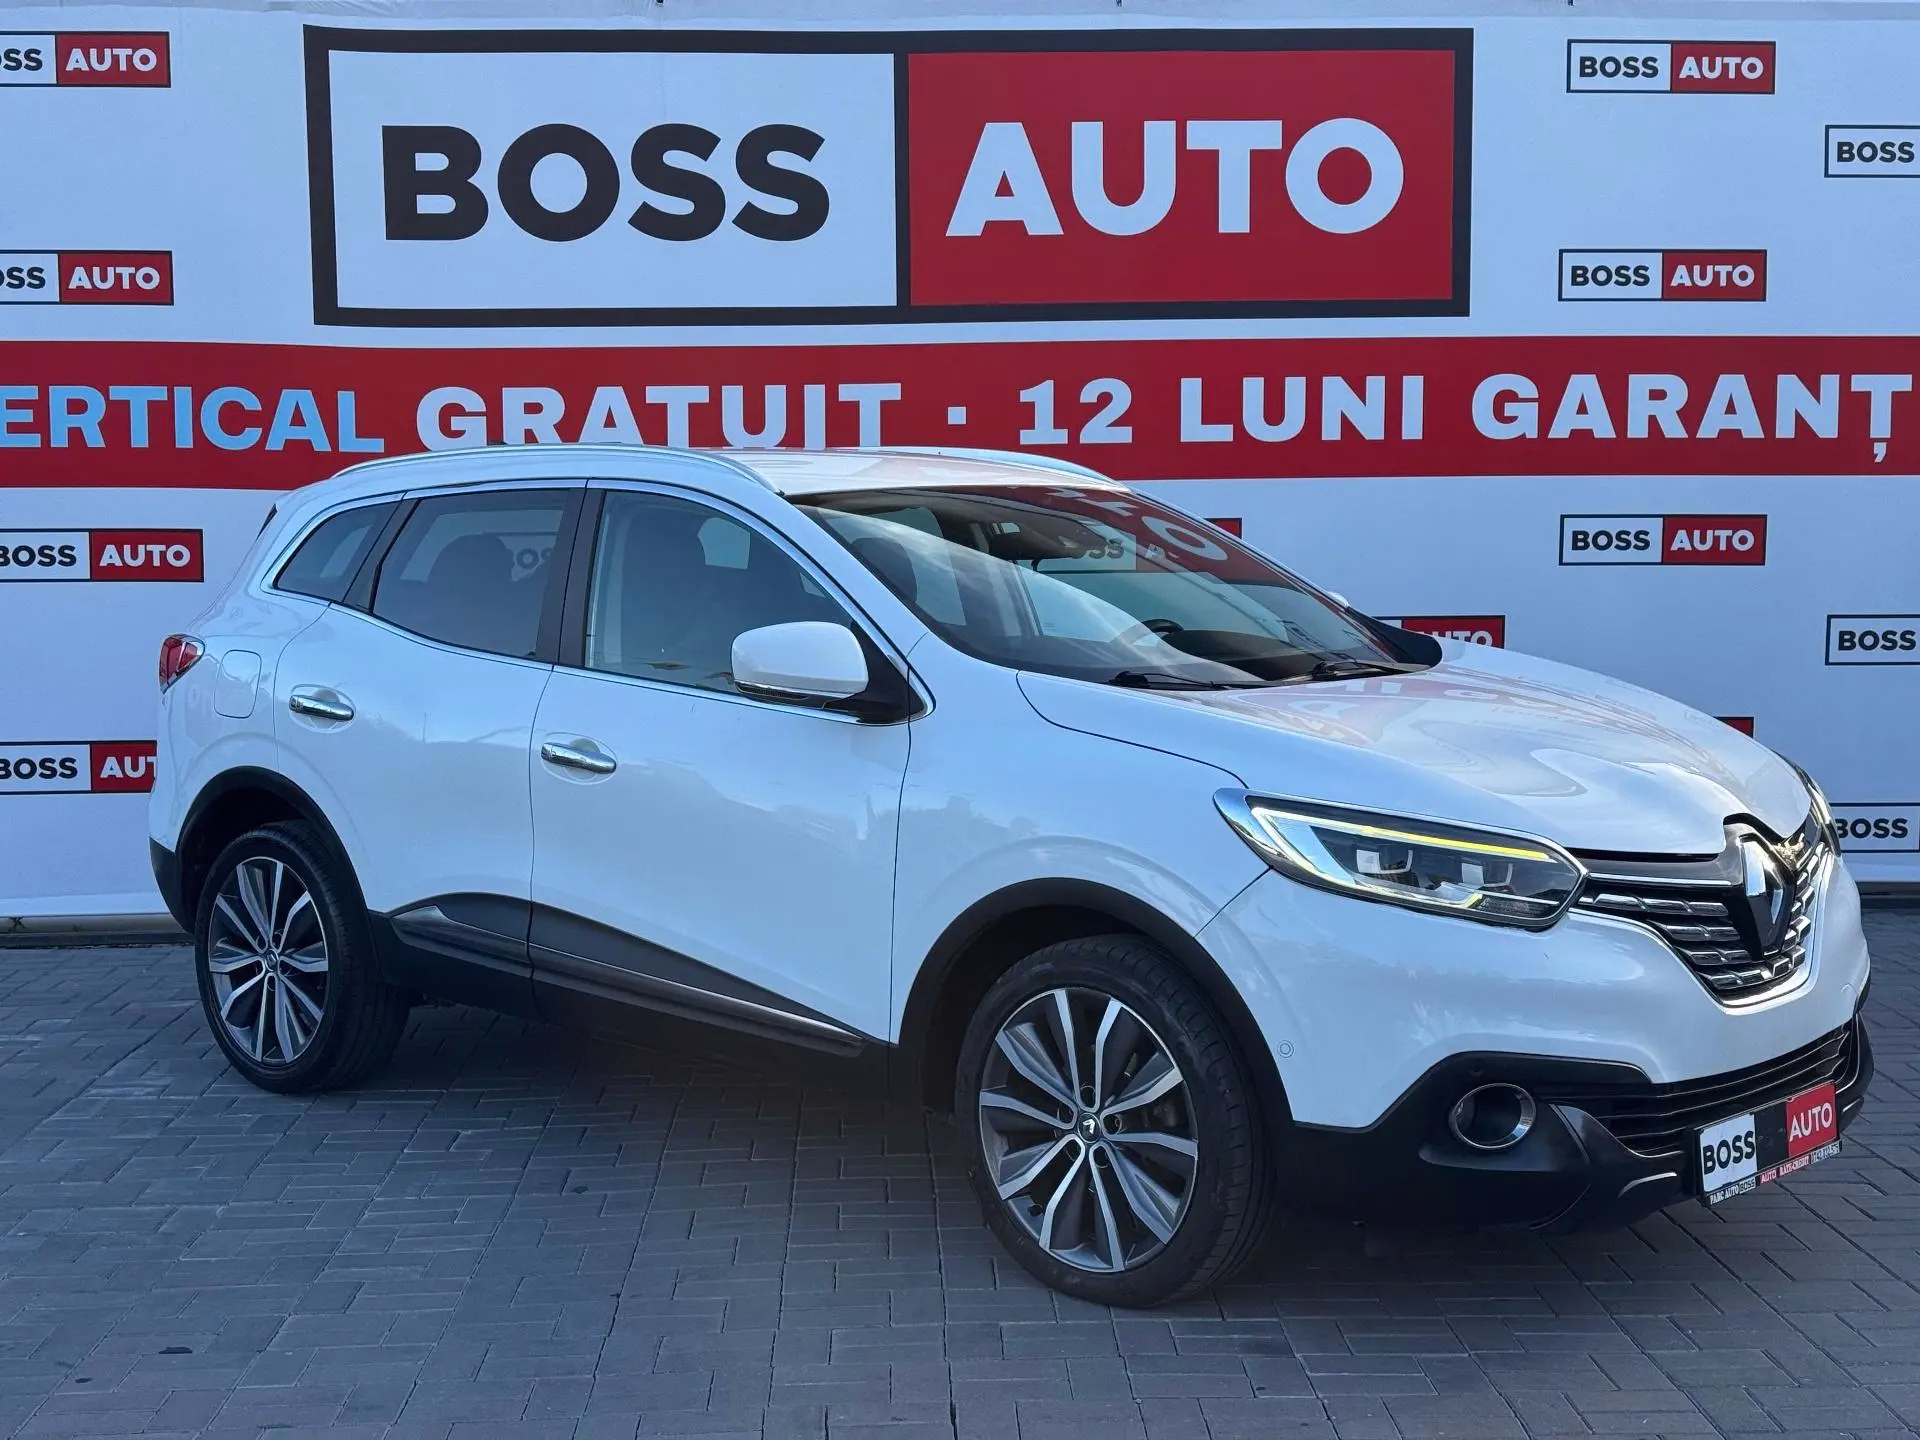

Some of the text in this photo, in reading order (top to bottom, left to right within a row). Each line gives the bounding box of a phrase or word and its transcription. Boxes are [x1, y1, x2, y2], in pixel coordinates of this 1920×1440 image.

[0, 48, 158, 72] SS AUTO
[1578, 56, 1765, 80] BOSS AUTO
[1836, 141, 1915, 163] BOSS
[381, 117, 1405, 241] BOSS AUTO
[0, 266, 160, 290] SS AUTO
[1570, 265, 1756, 288] BOSS AUTO
[416, 383, 902, 452] GRATUIT
[1018, 378, 1133, 445] 12
[1180, 375, 1425, 444] LUNI
[1571, 529, 1756, 552] BOSS AUTO
[99, 544, 191, 567] AUTO
[1838, 629, 1917, 651] BOSS
[1835, 818, 1908, 839] BOSS
[1703, 1102, 1833, 1175] BOSS AUTO
[1725, 1184, 1739, 1200] AUTO
